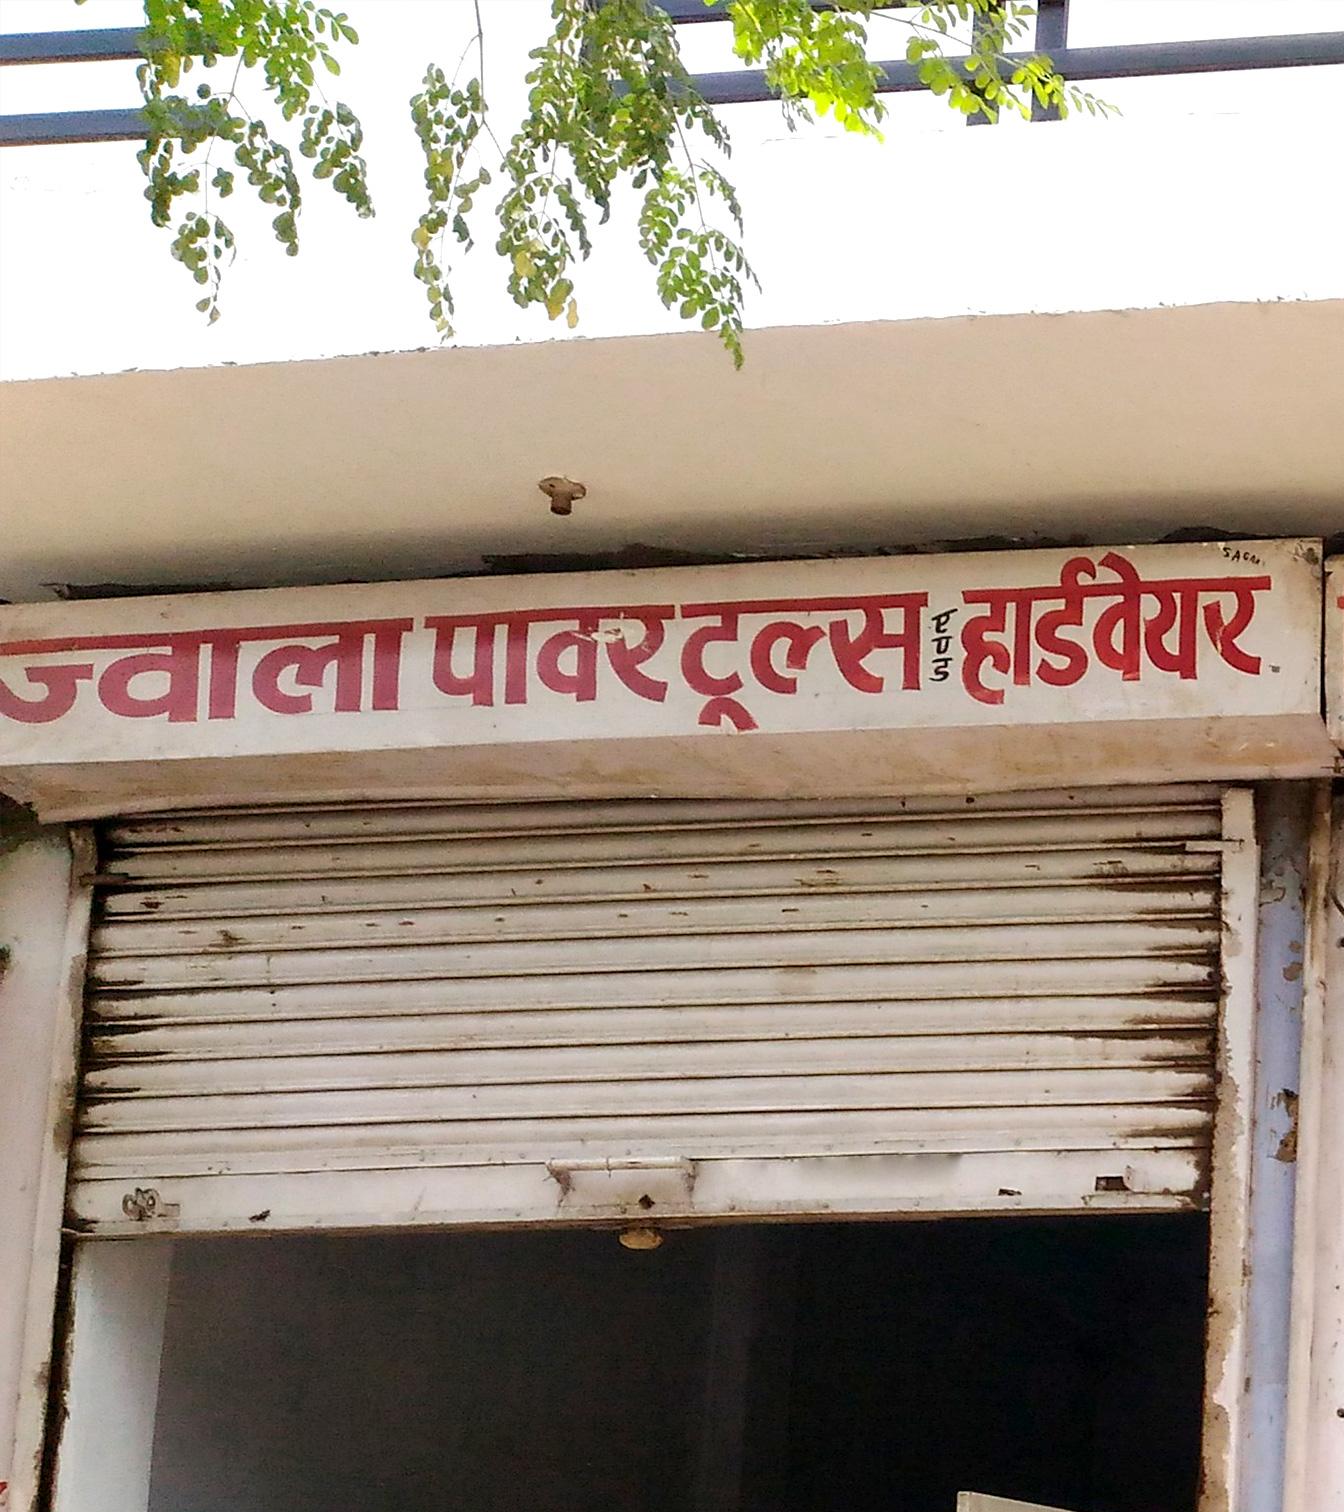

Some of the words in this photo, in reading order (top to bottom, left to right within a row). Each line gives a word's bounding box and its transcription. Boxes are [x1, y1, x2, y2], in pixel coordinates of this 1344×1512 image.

[0, 617, 413, 722] ज्वाला
[424, 604, 675, 703] पावर
[681, 591, 929, 731] टूल्स
[960, 551, 1271, 704] हार्डवेयर
